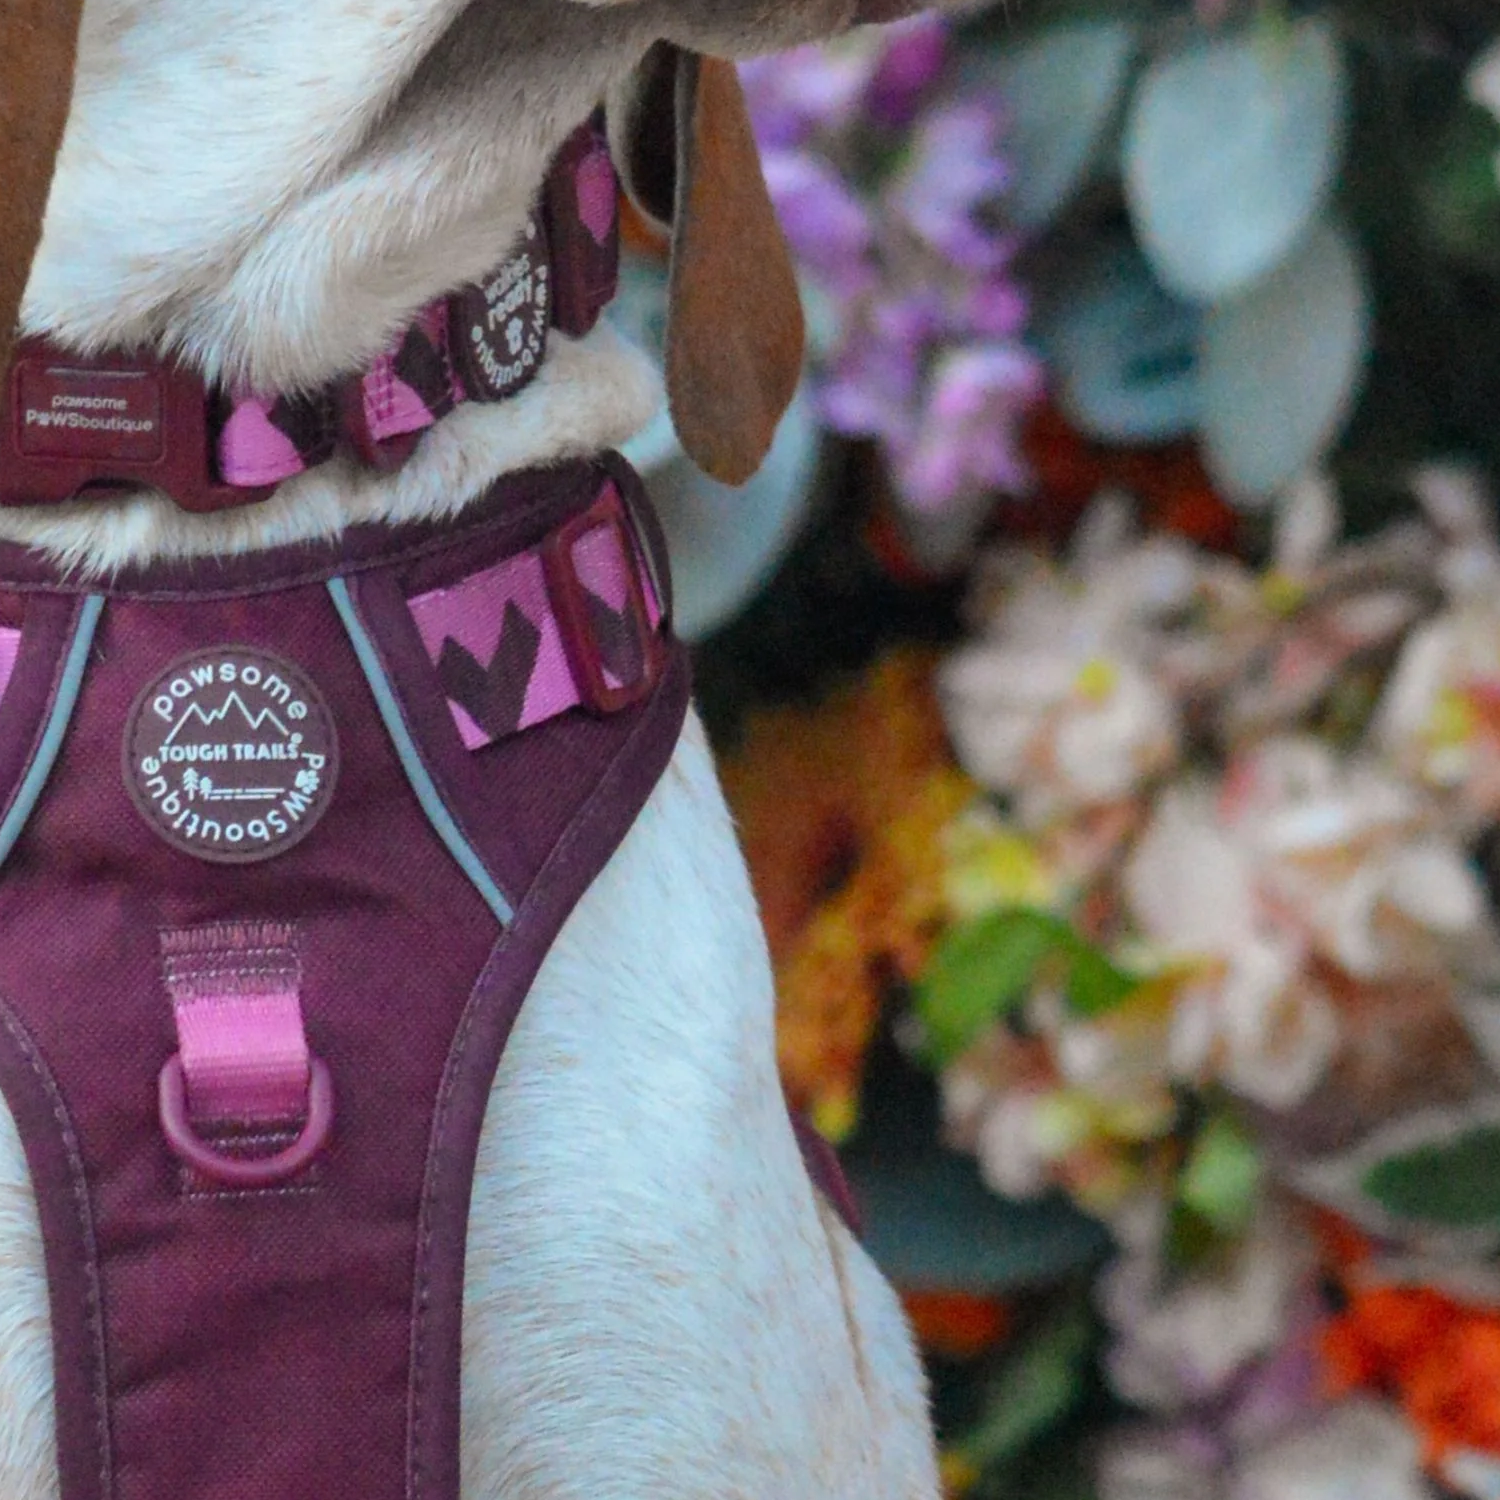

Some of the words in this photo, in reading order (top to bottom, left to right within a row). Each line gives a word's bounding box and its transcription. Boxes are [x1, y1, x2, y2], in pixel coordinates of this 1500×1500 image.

[51, 394, 128, 411] pawsome
[153, 663, 308, 722] pawsome
[158, 744, 228, 763] TOUGH
[232, 743, 299, 761] TRAILS
